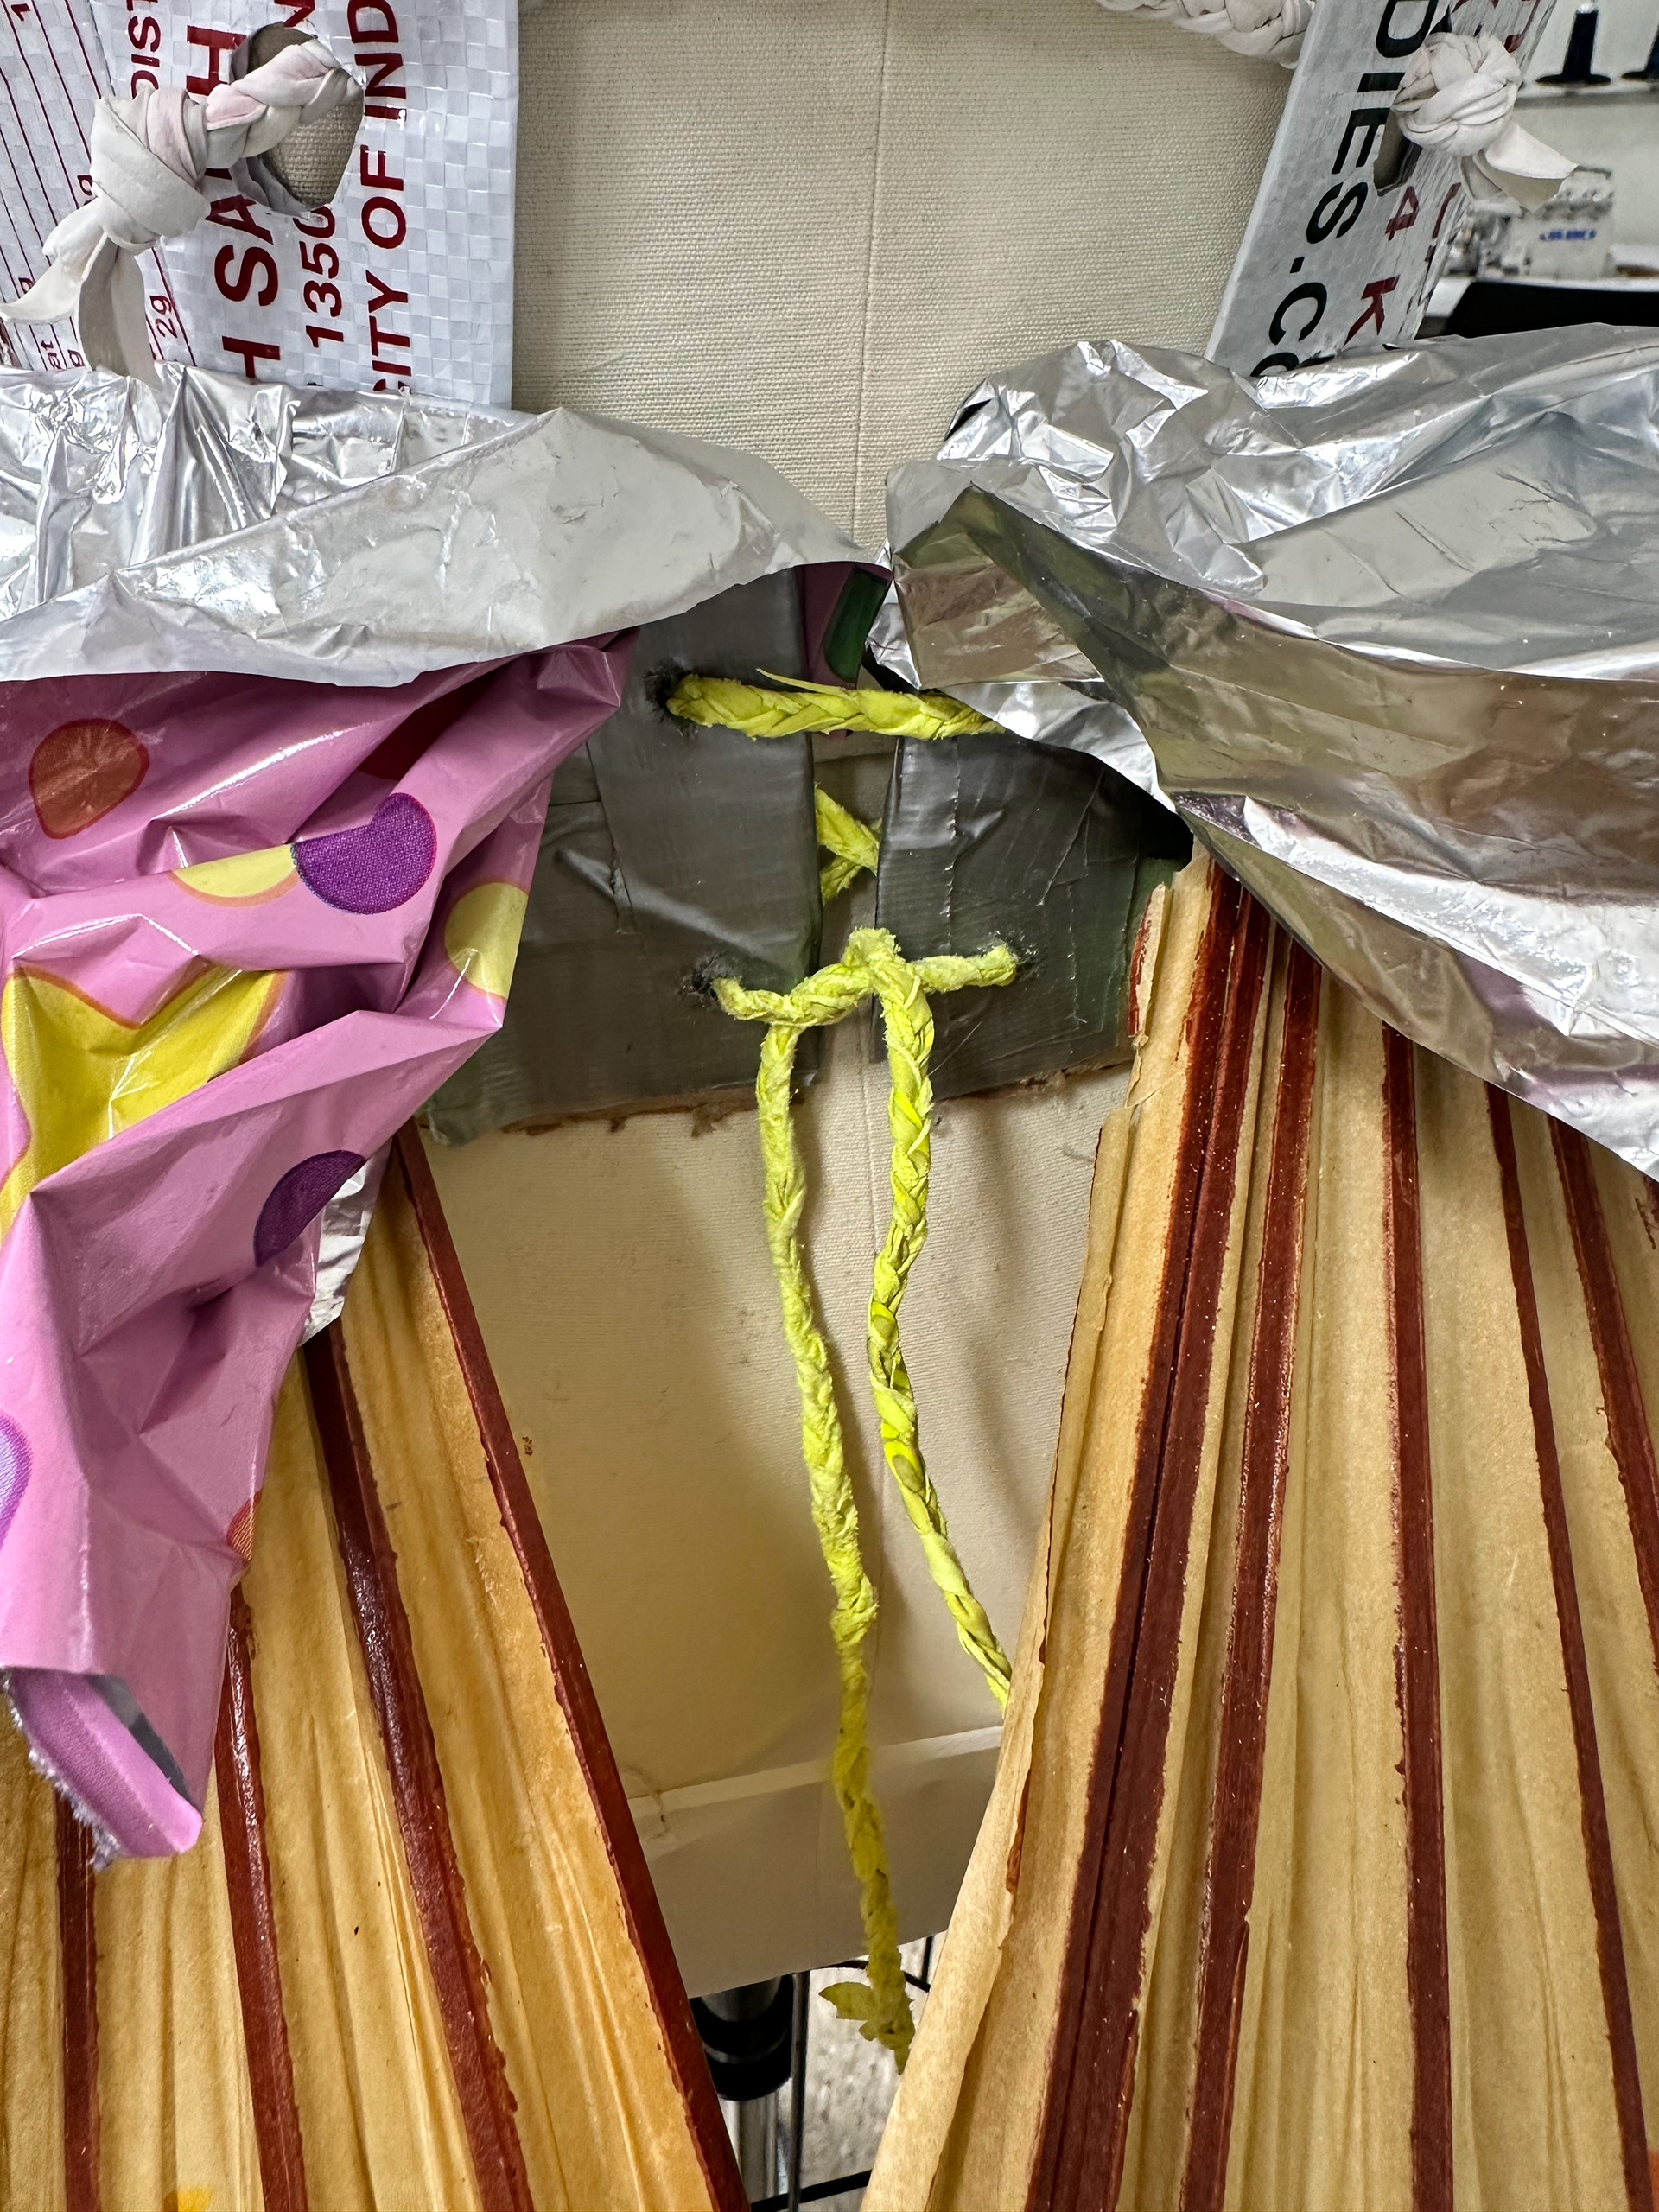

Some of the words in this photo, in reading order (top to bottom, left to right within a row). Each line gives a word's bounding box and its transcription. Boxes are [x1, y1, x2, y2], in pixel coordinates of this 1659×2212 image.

[347, 0, 407, 121] IND
[359, 144, 407, 249] OF
[365, 270, 412, 391] ITY
